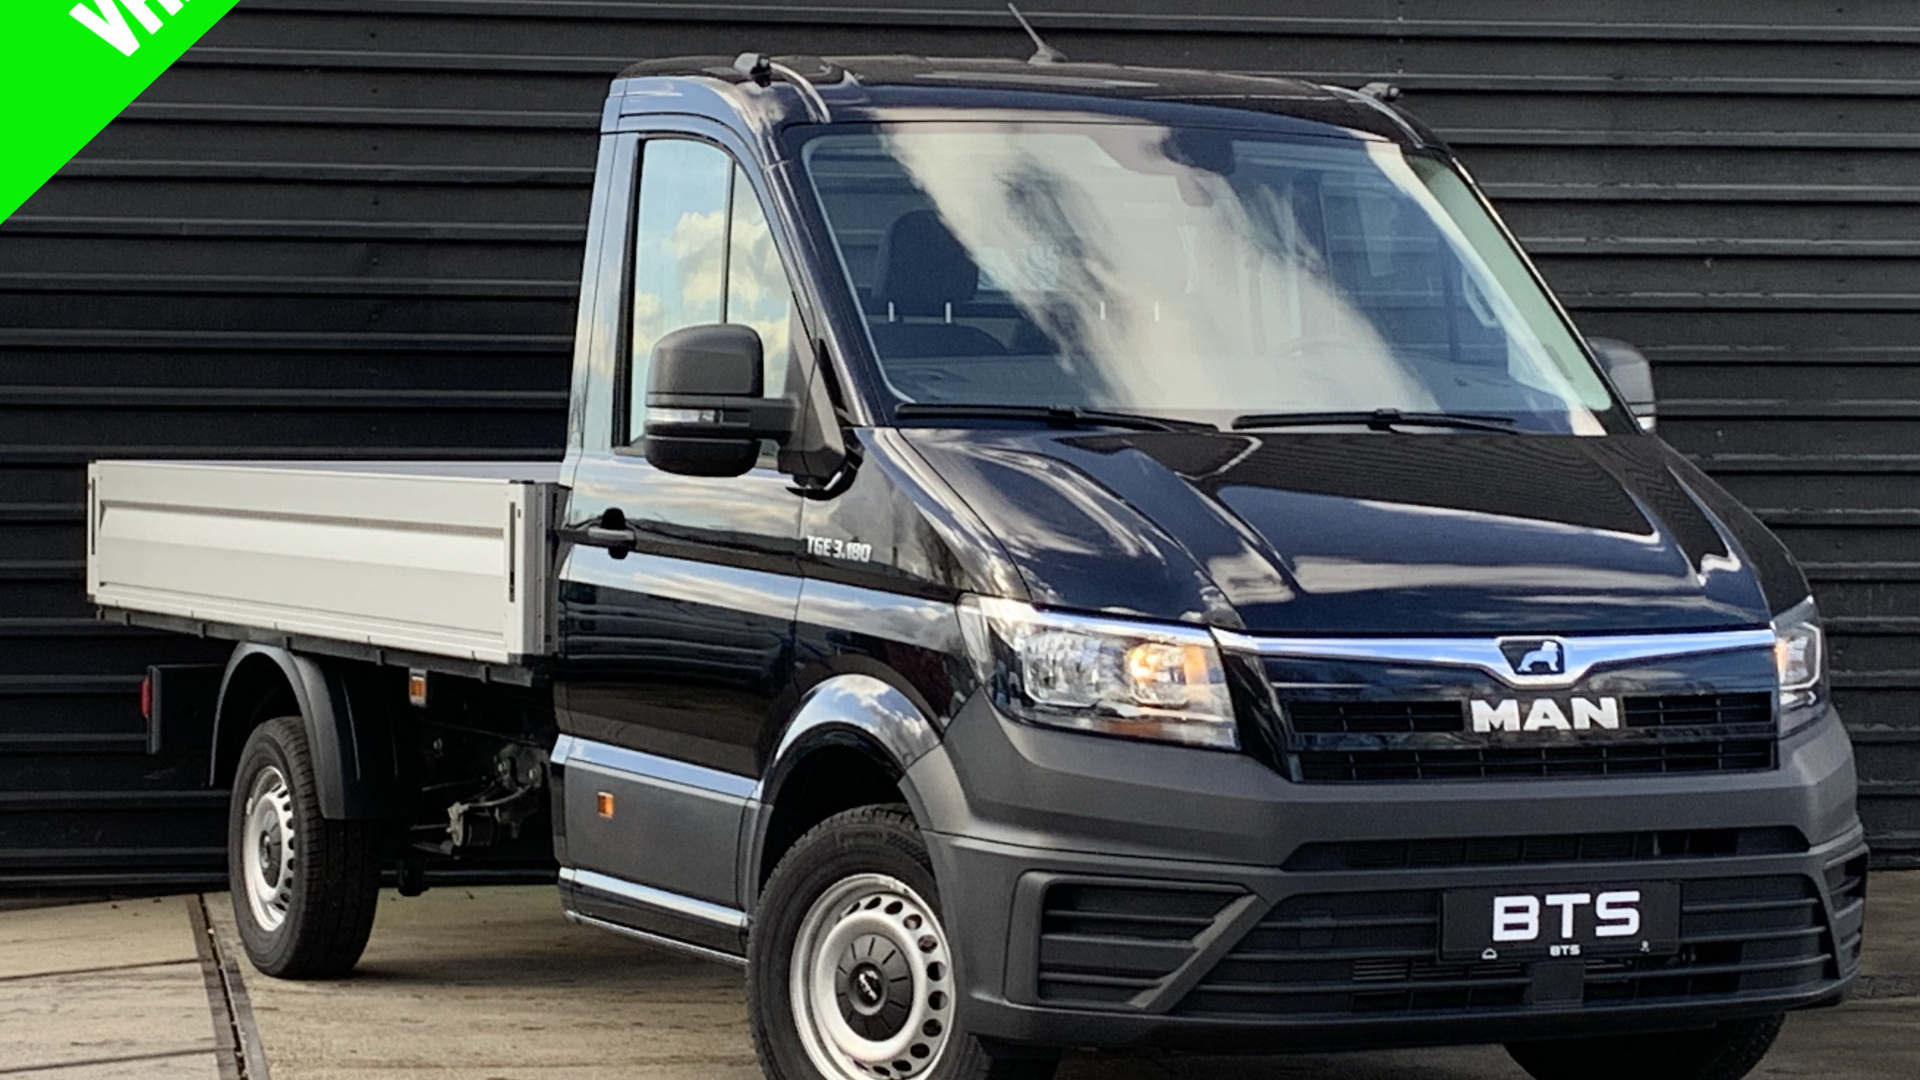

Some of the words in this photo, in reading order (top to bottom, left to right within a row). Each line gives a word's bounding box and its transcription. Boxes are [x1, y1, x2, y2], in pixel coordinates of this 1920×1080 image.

[1470, 697, 1619, 732] MAN
[1492, 890, 1641, 942] BTS
[1550, 944, 1580, 957] BTS
